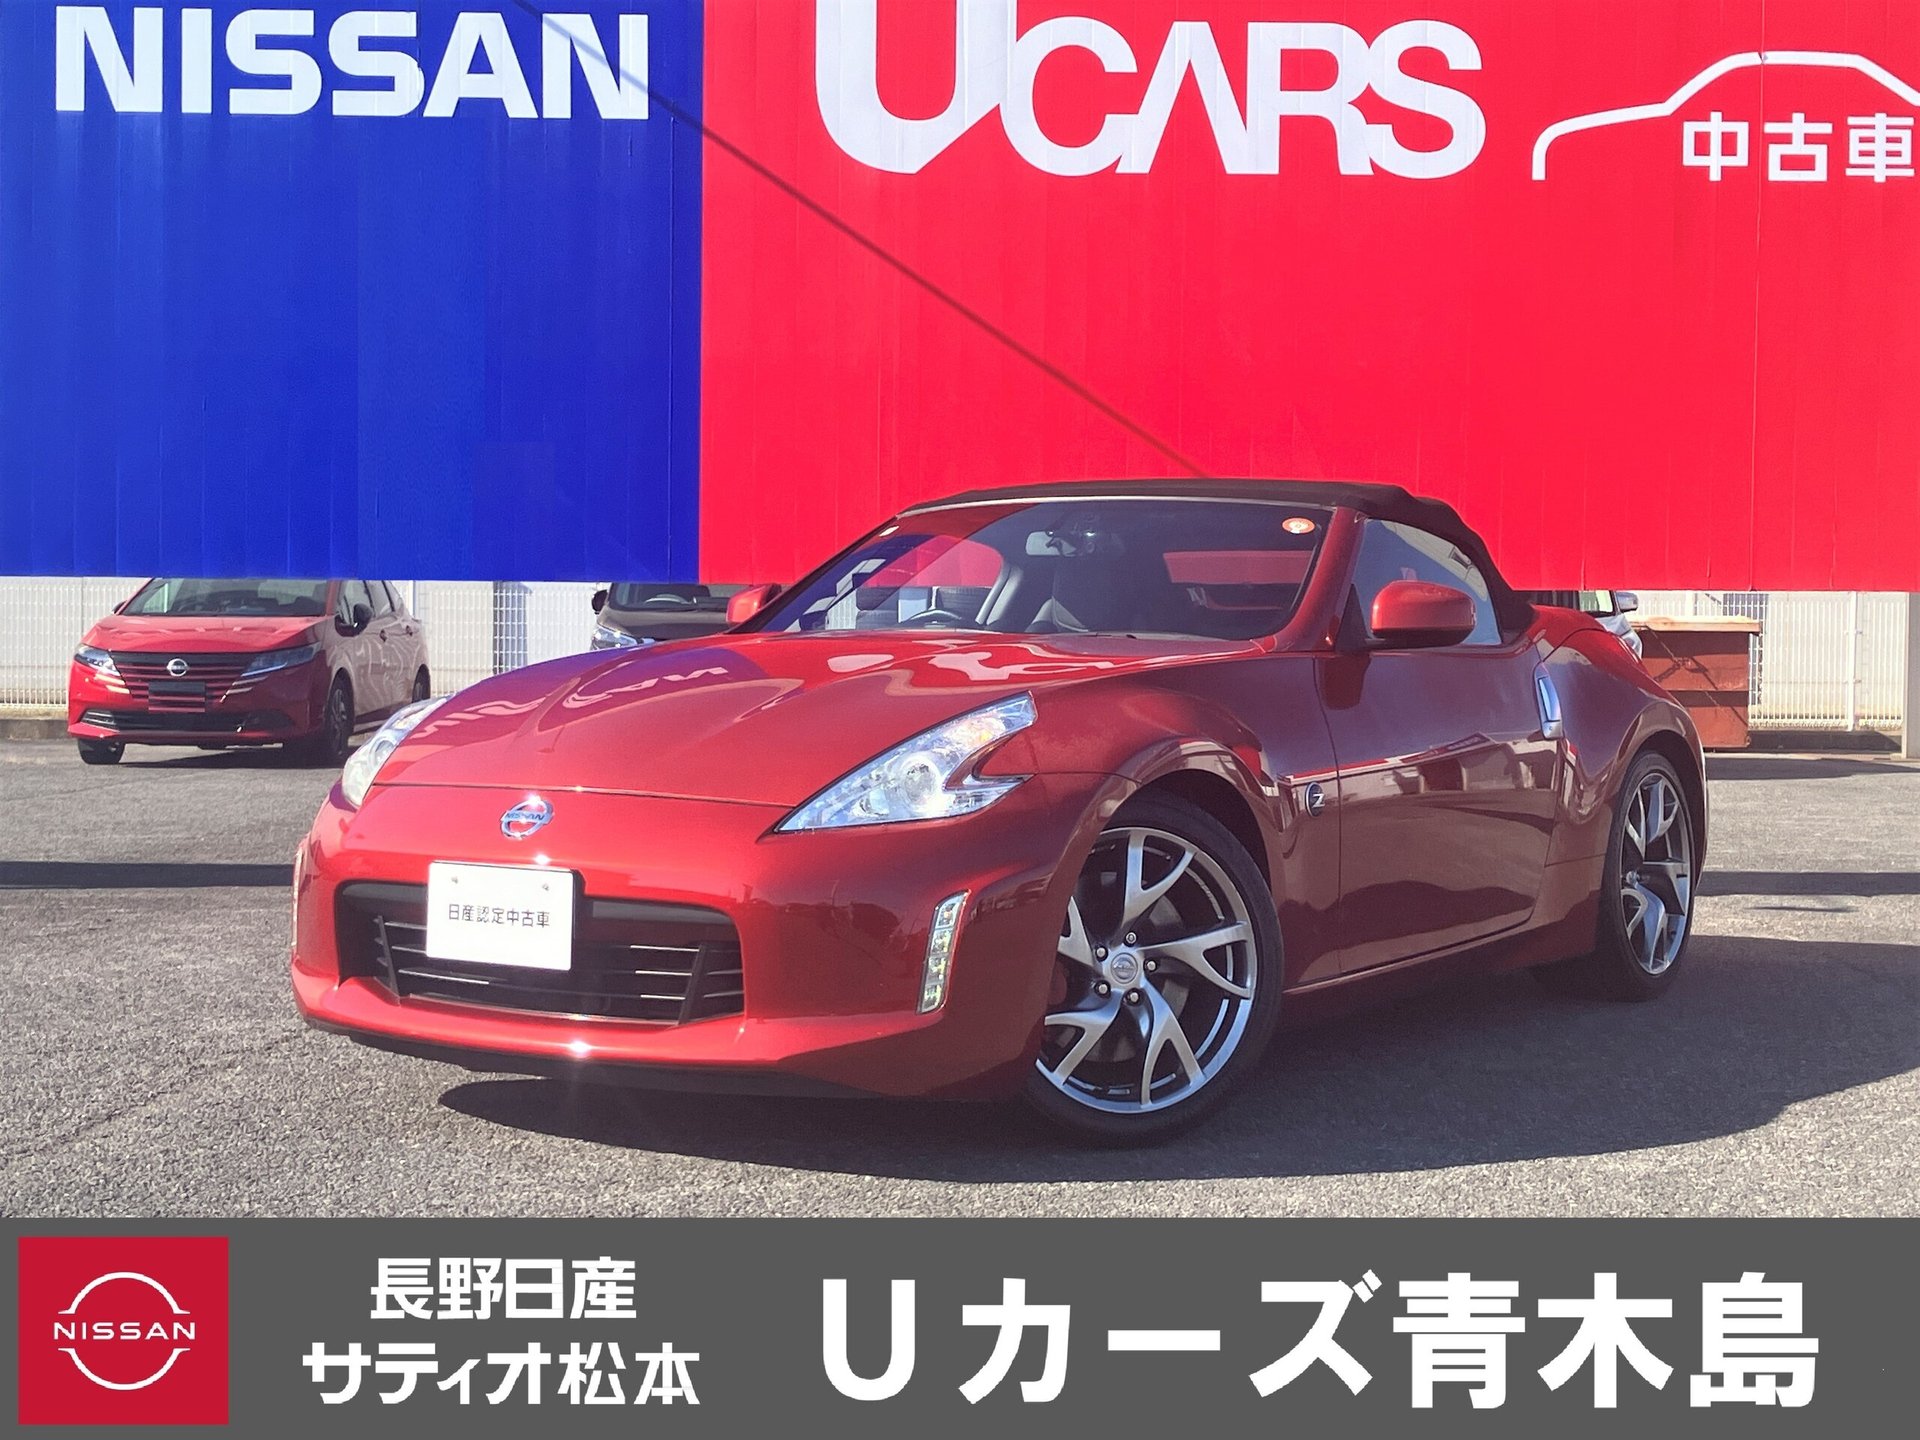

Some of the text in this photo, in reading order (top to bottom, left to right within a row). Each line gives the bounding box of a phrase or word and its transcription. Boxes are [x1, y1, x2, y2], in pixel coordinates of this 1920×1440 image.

[55, 6, 649, 120] NISSAN
[1682, 111, 1915, 182] 中古車
[448, 903, 551, 928] 日産認定中古車
